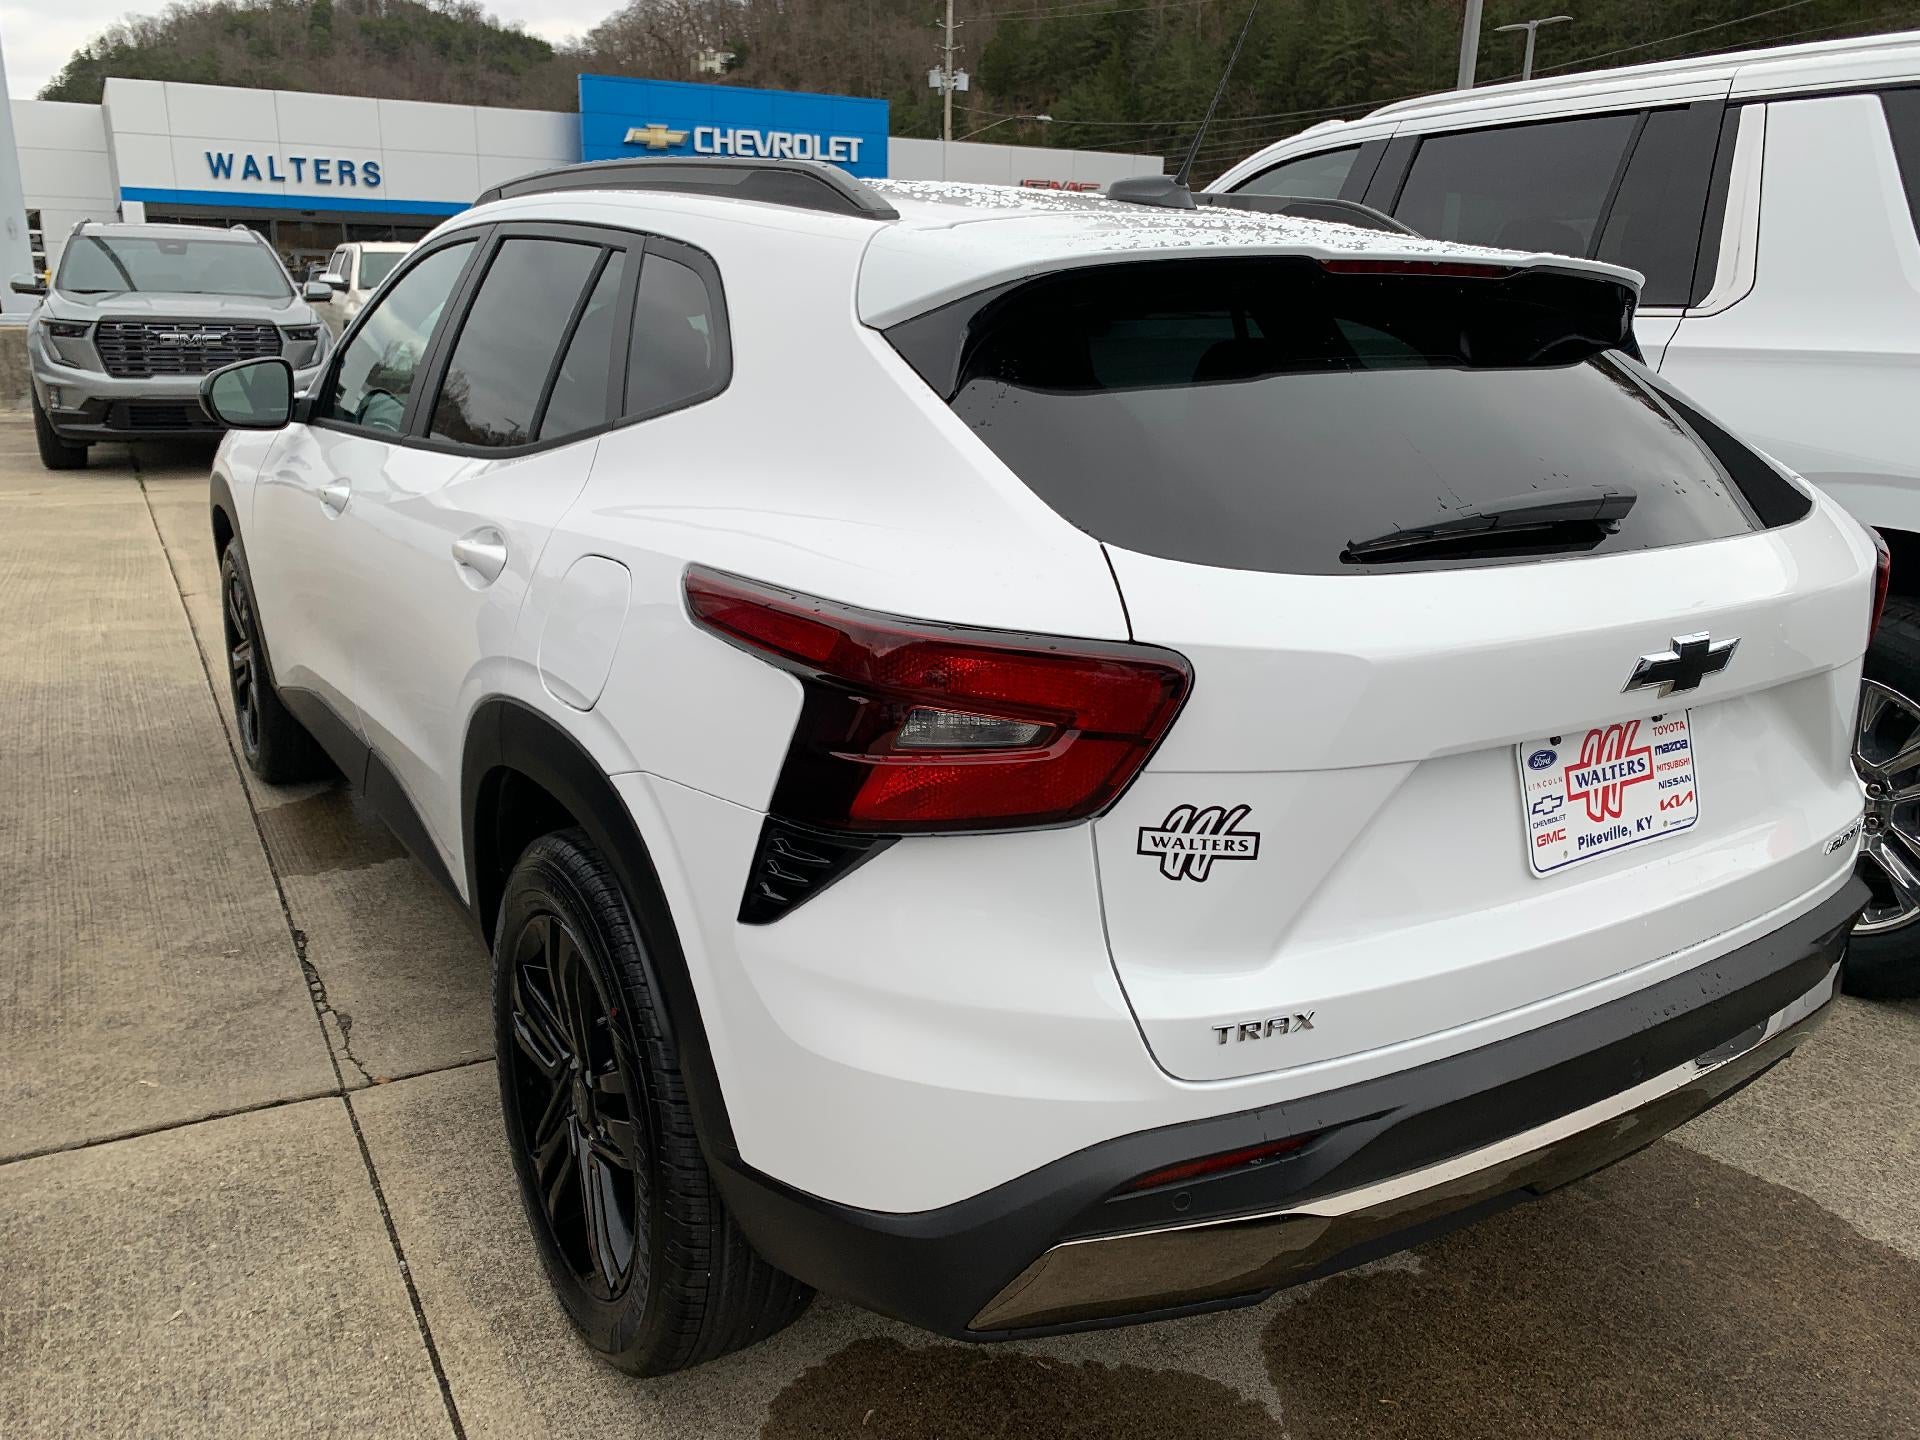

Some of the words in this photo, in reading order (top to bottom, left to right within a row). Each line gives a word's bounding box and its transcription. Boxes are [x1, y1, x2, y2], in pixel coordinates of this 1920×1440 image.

[693, 126, 864, 162] CHEVROLET
[205, 151, 381, 187] WALTERS
[159, 333, 222, 346] GMC
[1652, 720, 1686, 737] TOYOTA
[1654, 739, 1689, 756] mazda
[1574, 757, 1646, 788] WALTERS
[1656, 757, 1691, 772] MITSUBISHI
[1528, 776, 1563, 791] LINCOLN
[1658, 774, 1692, 790] NISSAN
[1532, 814, 1567, 829] CHEVROLET
[1536, 828, 1567, 847] GMC
[1577, 825, 1632, 850] Pikeville,
[1636, 815, 1652, 832] KY
[1150, 835, 1249, 852] WALTERS
[1211, 1009, 1316, 1045] TRAX
